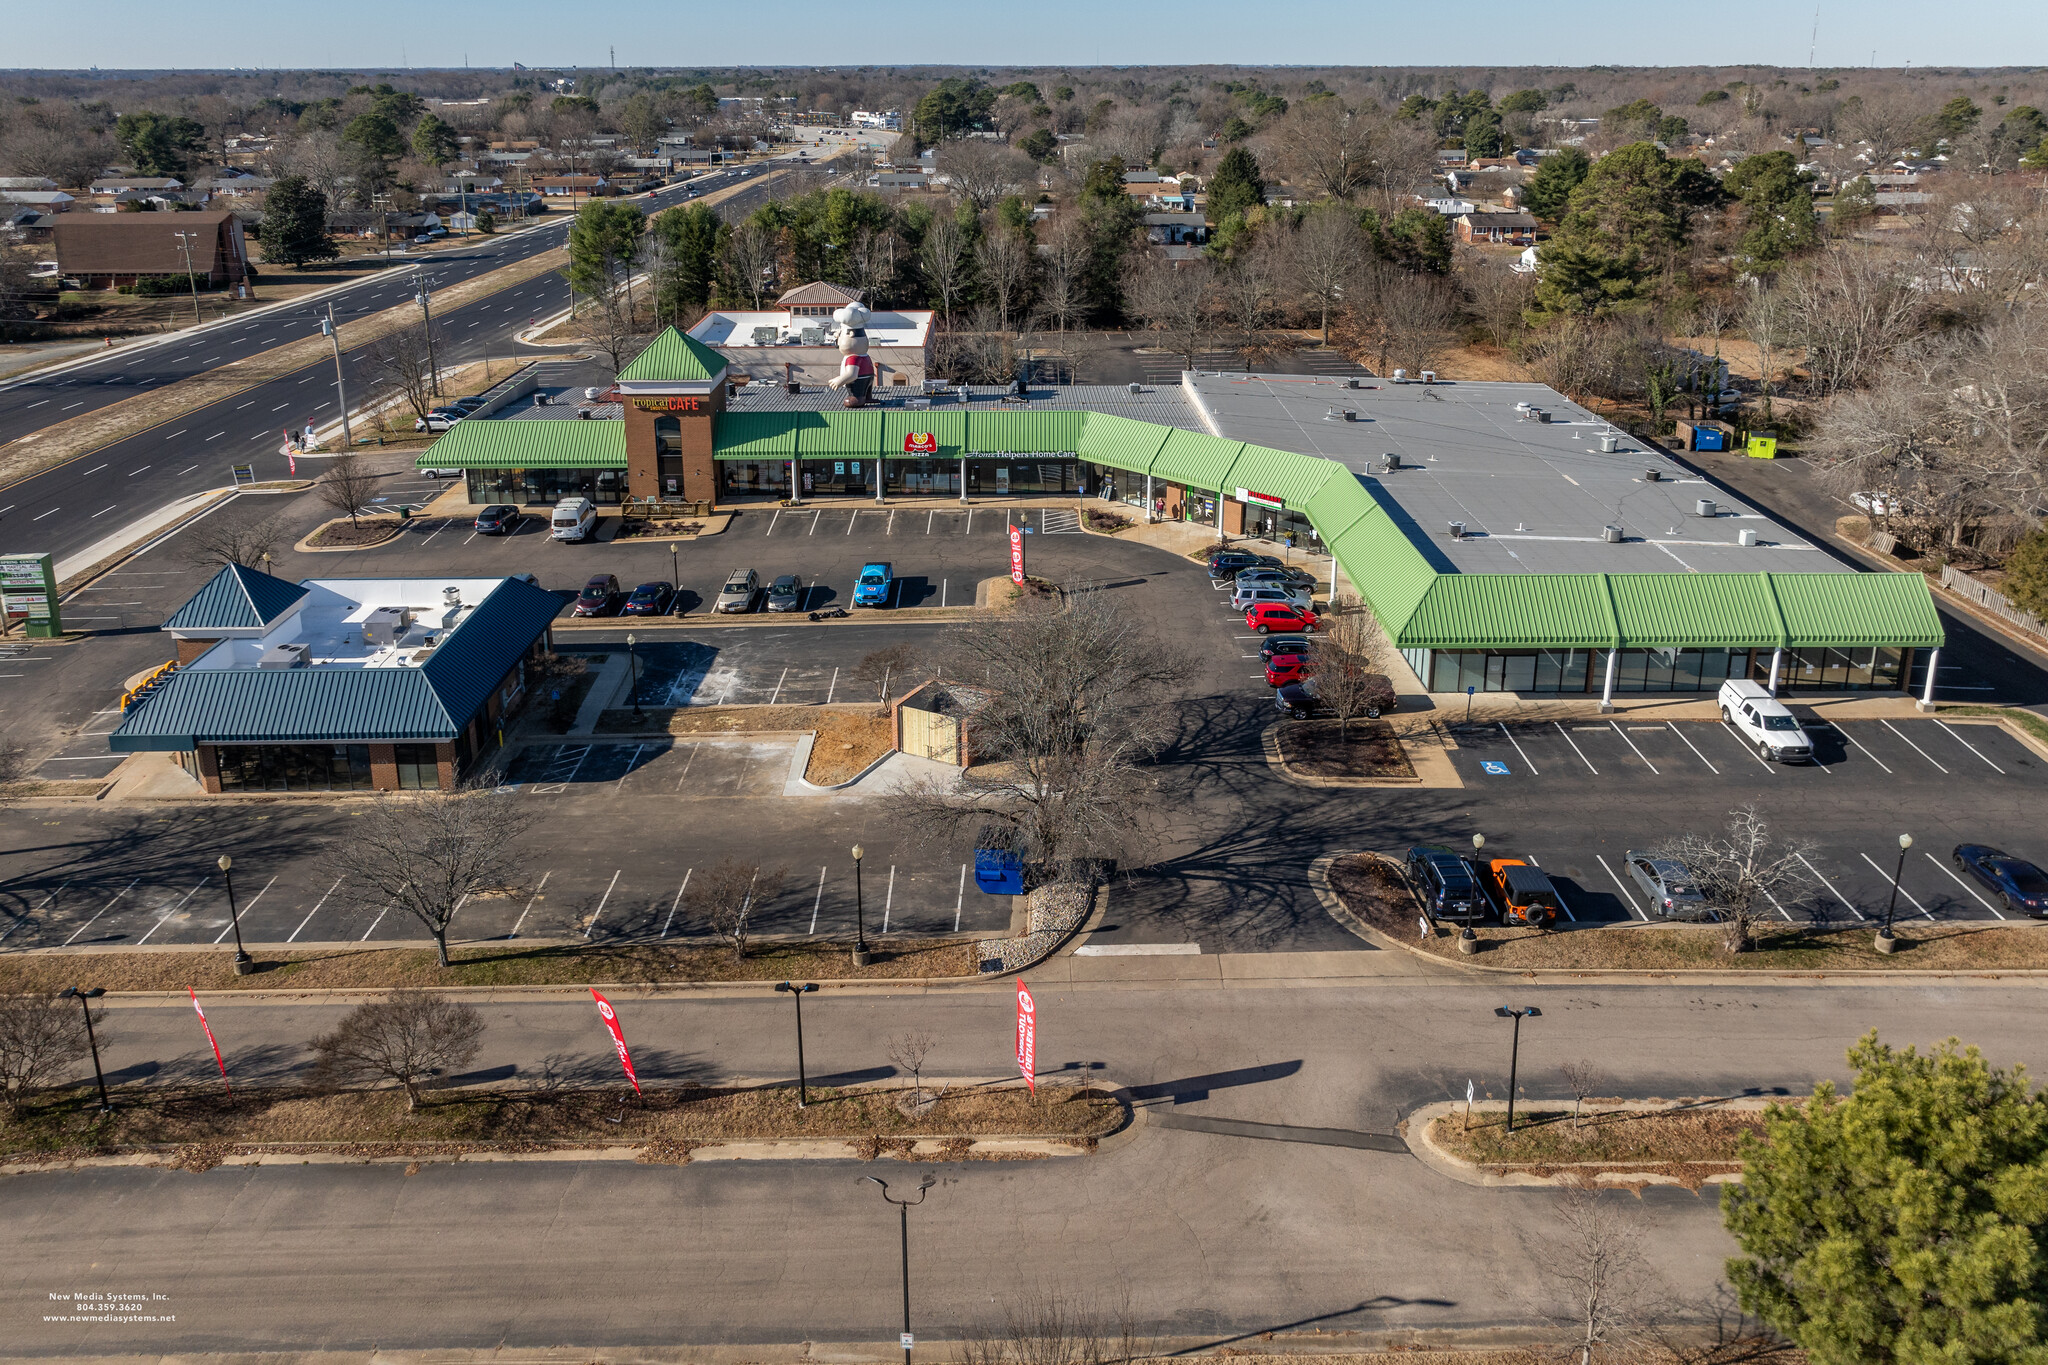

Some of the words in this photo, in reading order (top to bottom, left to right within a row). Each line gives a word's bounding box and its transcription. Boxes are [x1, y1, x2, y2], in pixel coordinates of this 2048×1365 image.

[632, 396, 668, 408] tropical
[669, 396, 699, 411] CAFE
[996, 449, 1029, 460] Helpers
[1031, 450, 1056, 458] Home
[1057, 450, 1076, 458] Care
[1248, 491, 1281, 503] VETERINARY
